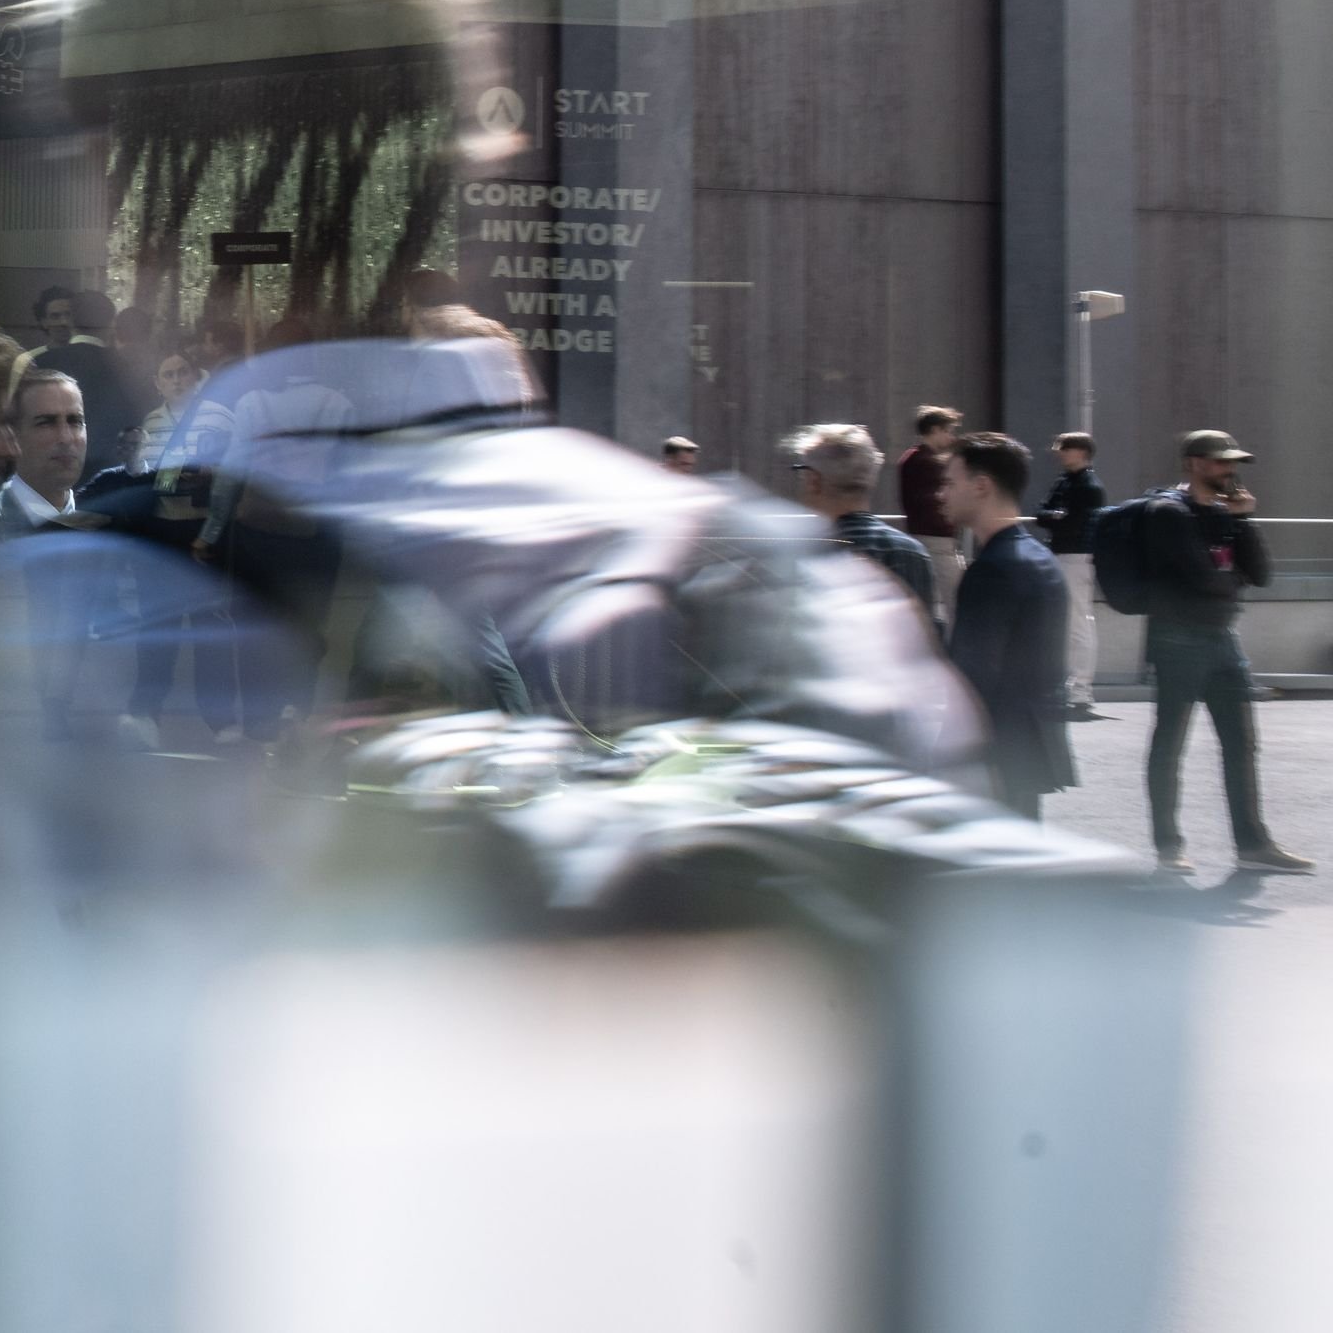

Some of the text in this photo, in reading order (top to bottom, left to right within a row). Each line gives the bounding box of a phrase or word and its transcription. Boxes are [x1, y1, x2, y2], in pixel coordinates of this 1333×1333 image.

[555, 89, 650, 114] START
[555, 122, 634, 140] SUMMIT
[464, 182, 660, 212] CORPORATE/
[481, 220, 644, 248] INVESTOR/
[492, 256, 633, 282] ALREADY
[506, 291, 617, 318] WITH A
